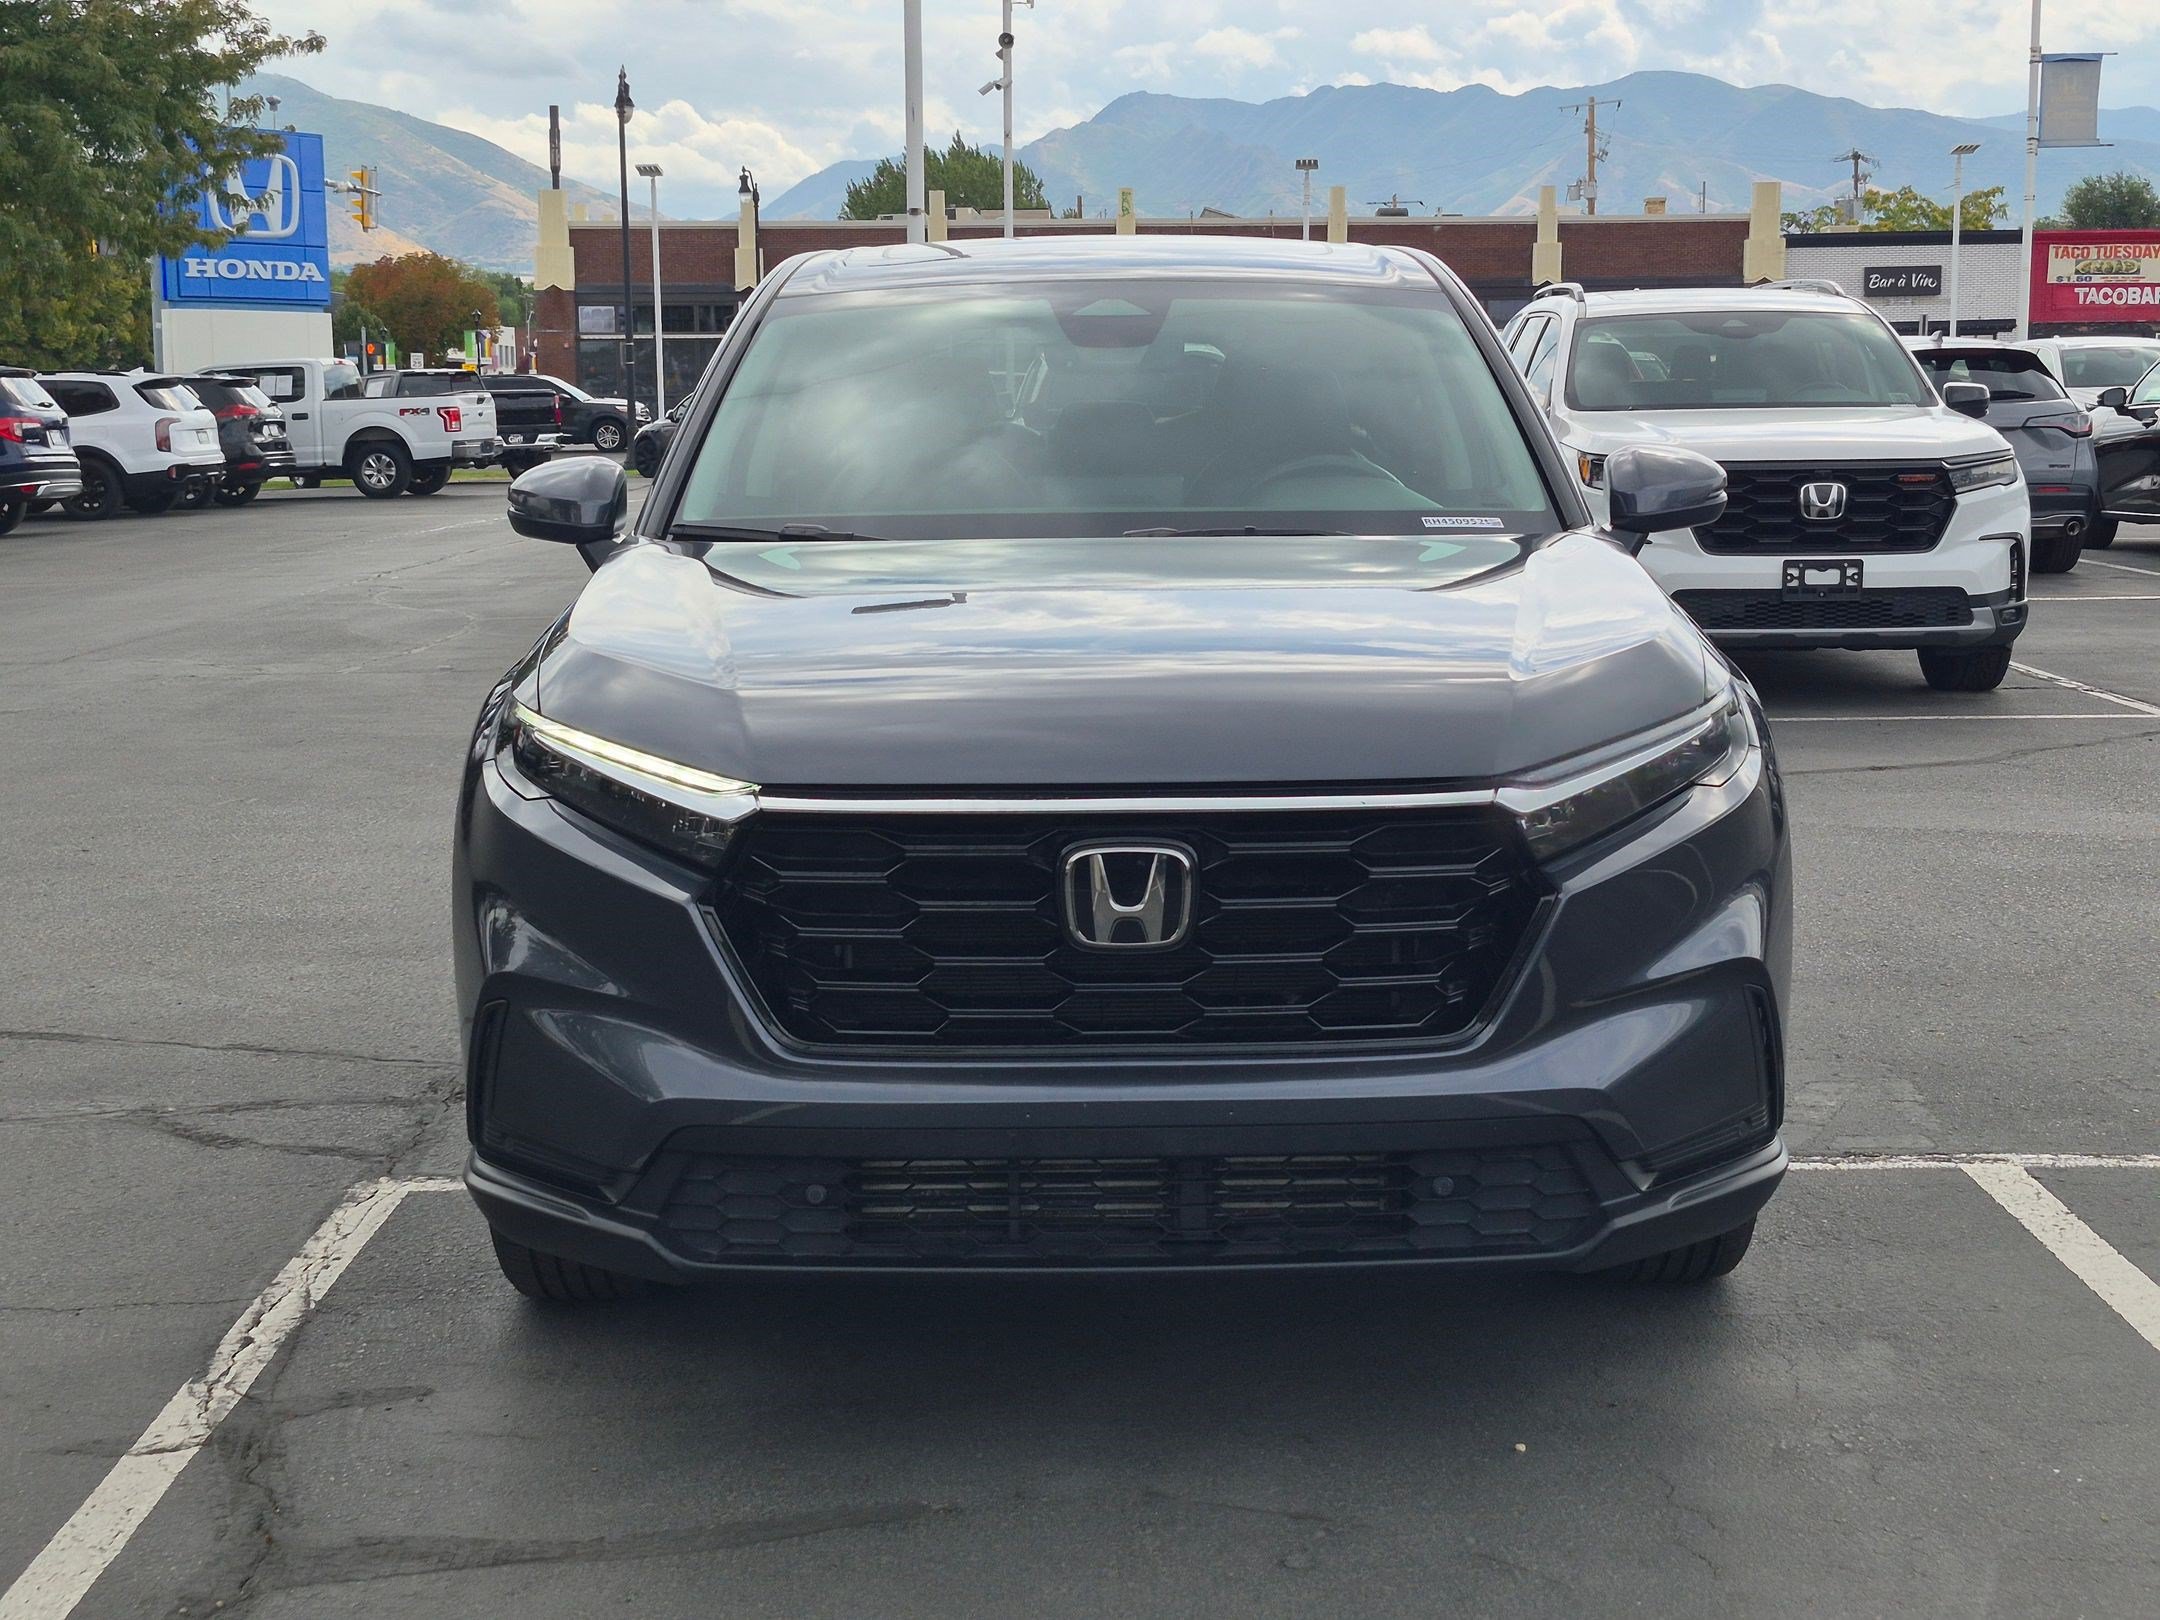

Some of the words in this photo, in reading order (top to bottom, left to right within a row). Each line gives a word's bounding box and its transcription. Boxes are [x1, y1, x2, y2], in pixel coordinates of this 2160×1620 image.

[2053, 246, 2091, 259] TACO
[2094, 245, 2160, 259] TUESDAY
[185, 258, 325, 282] HONDA
[1868, 273, 1895, 289] Bar
[1897, 274, 1907, 287] à
[1911, 273, 1937, 288] Vin
[399, 407, 430, 416] FX4
